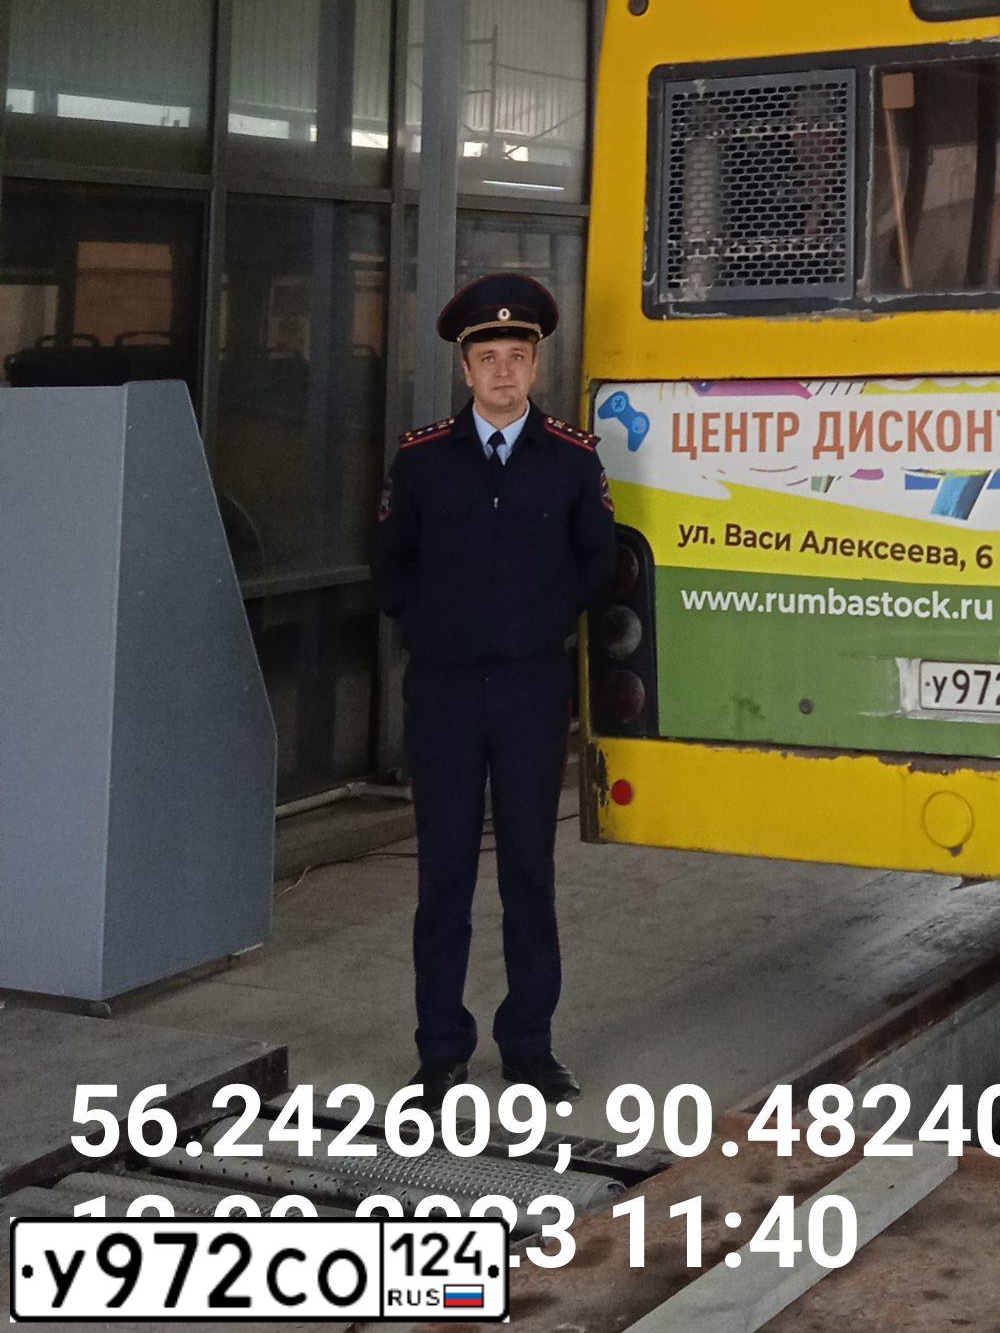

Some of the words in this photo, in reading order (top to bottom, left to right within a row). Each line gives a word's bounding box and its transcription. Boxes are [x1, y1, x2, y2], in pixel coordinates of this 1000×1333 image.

[670, 411, 800, 460] ЦЕНТР
[677, 521, 716, 548] ул.
[723, 523, 792, 552] Васи
[800, 529, 967, 572] Алексеева,
[975, 544, 995, 570] 6
[680, 587, 995, 622] www.rumbastock.ru
